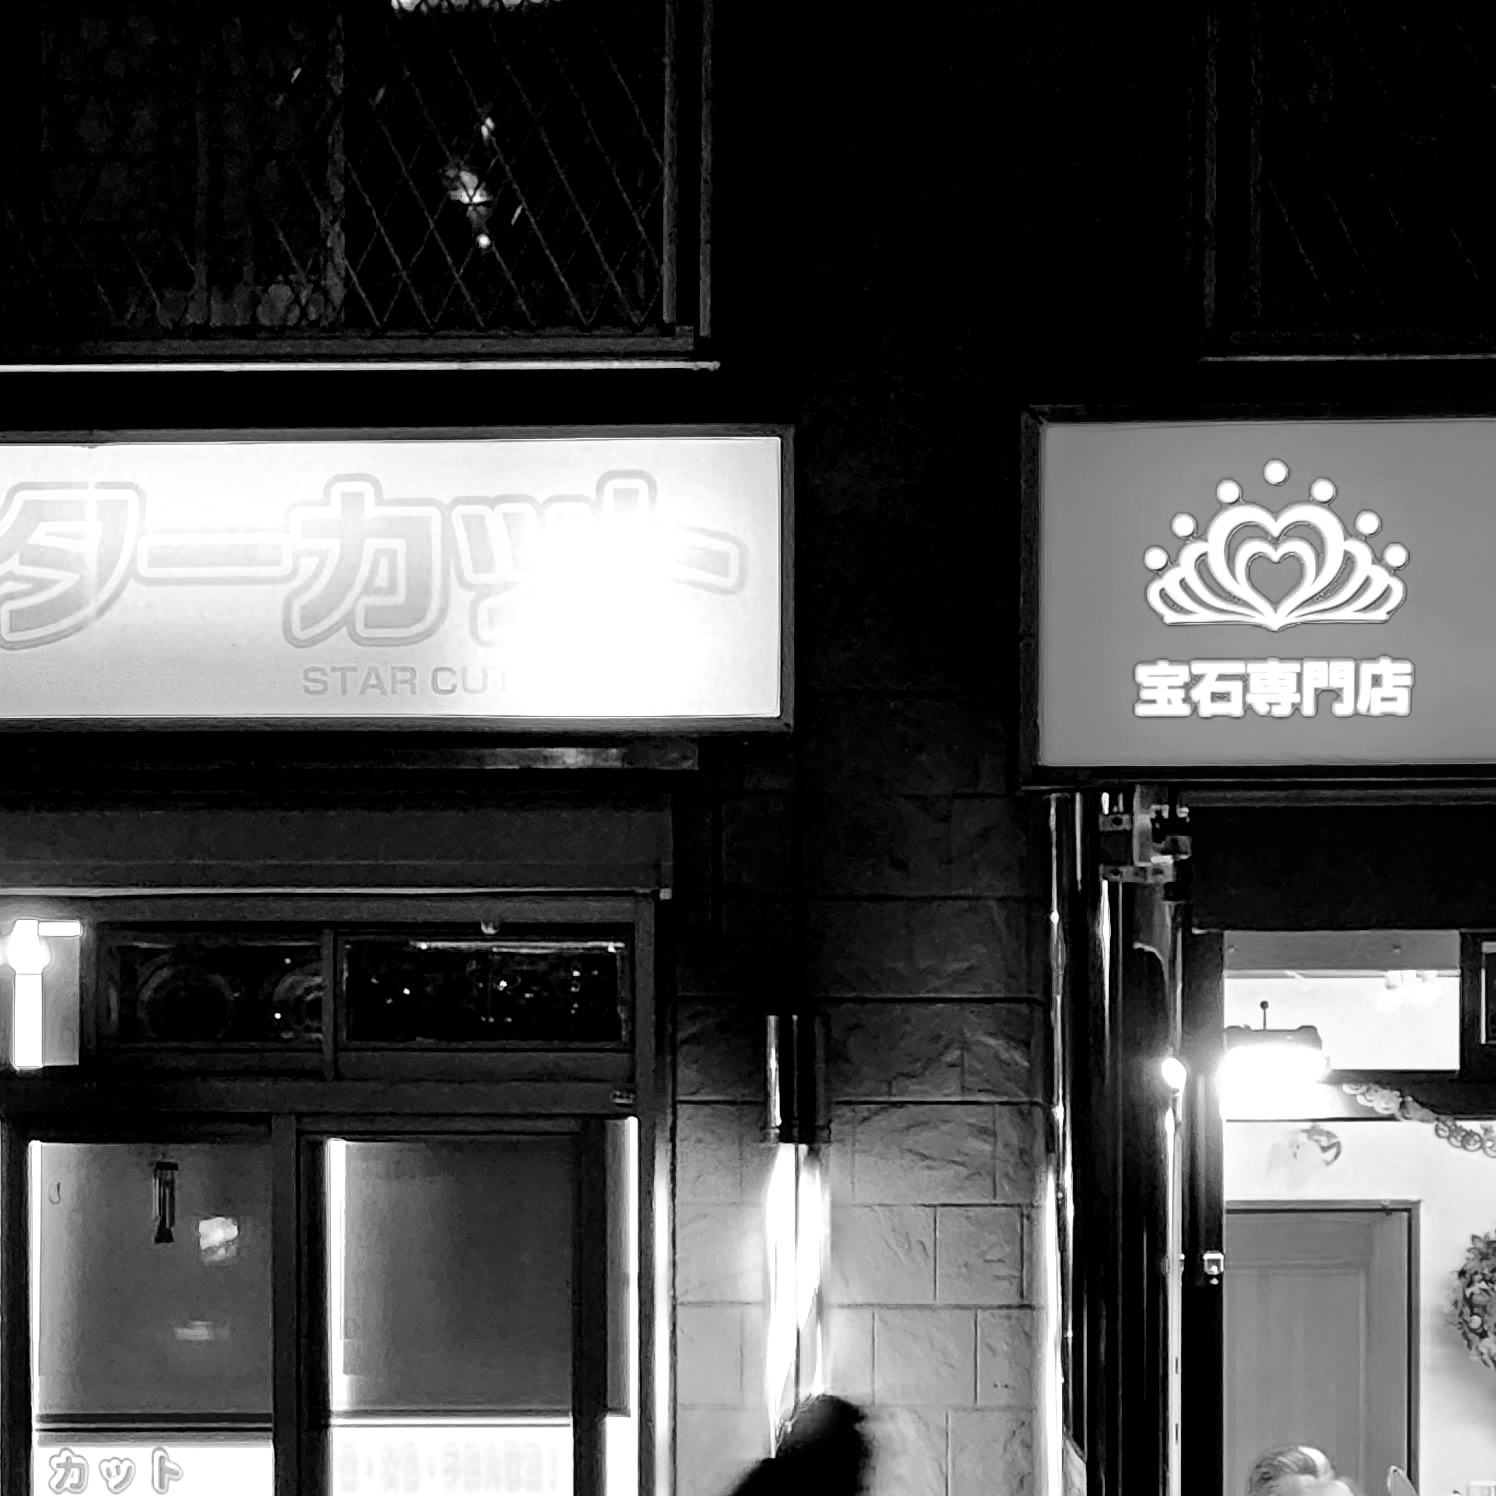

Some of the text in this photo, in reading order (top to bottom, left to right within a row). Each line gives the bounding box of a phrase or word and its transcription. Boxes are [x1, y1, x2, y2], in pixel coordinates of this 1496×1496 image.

[302, 665, 418, 695] STAR
[1133, 656, 1415, 718] 宝石専門店
[48, 1447, 184, 1494] カット
